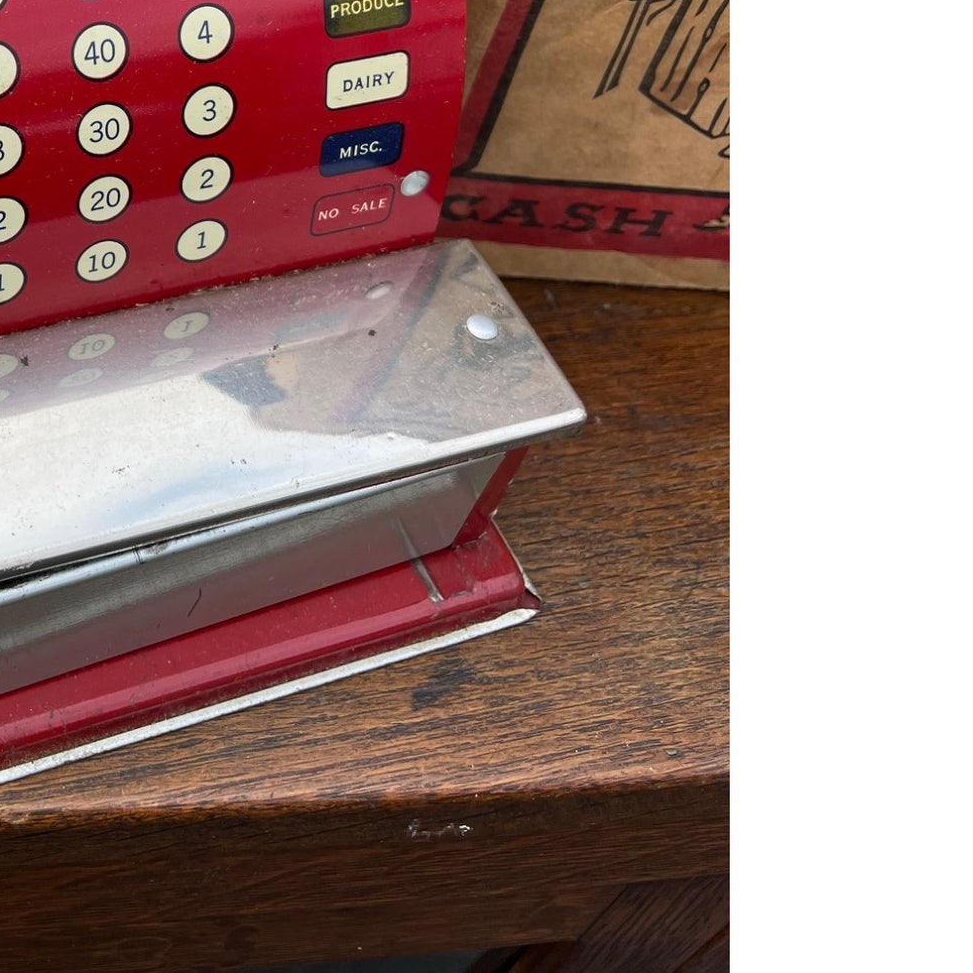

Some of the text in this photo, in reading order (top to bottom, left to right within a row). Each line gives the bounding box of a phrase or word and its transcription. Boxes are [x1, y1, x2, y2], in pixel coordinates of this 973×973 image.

[83, 38, 117, 67] 40
[197, 20, 213, 45] 4
[342, 72, 396, 94] DAIRY
[89, 117, 121, 143] 30
[201, 99, 217, 123] 3
[339, 140, 384, 160] MISC.
[90, 186, 122, 212] 20
[200, 169, 215, 189] 2
[317, 196, 388, 220] NO SALE
[441, 193, 674, 238] CASH
[87, 251, 117, 274] 10
[197, 230, 208, 251] 1
